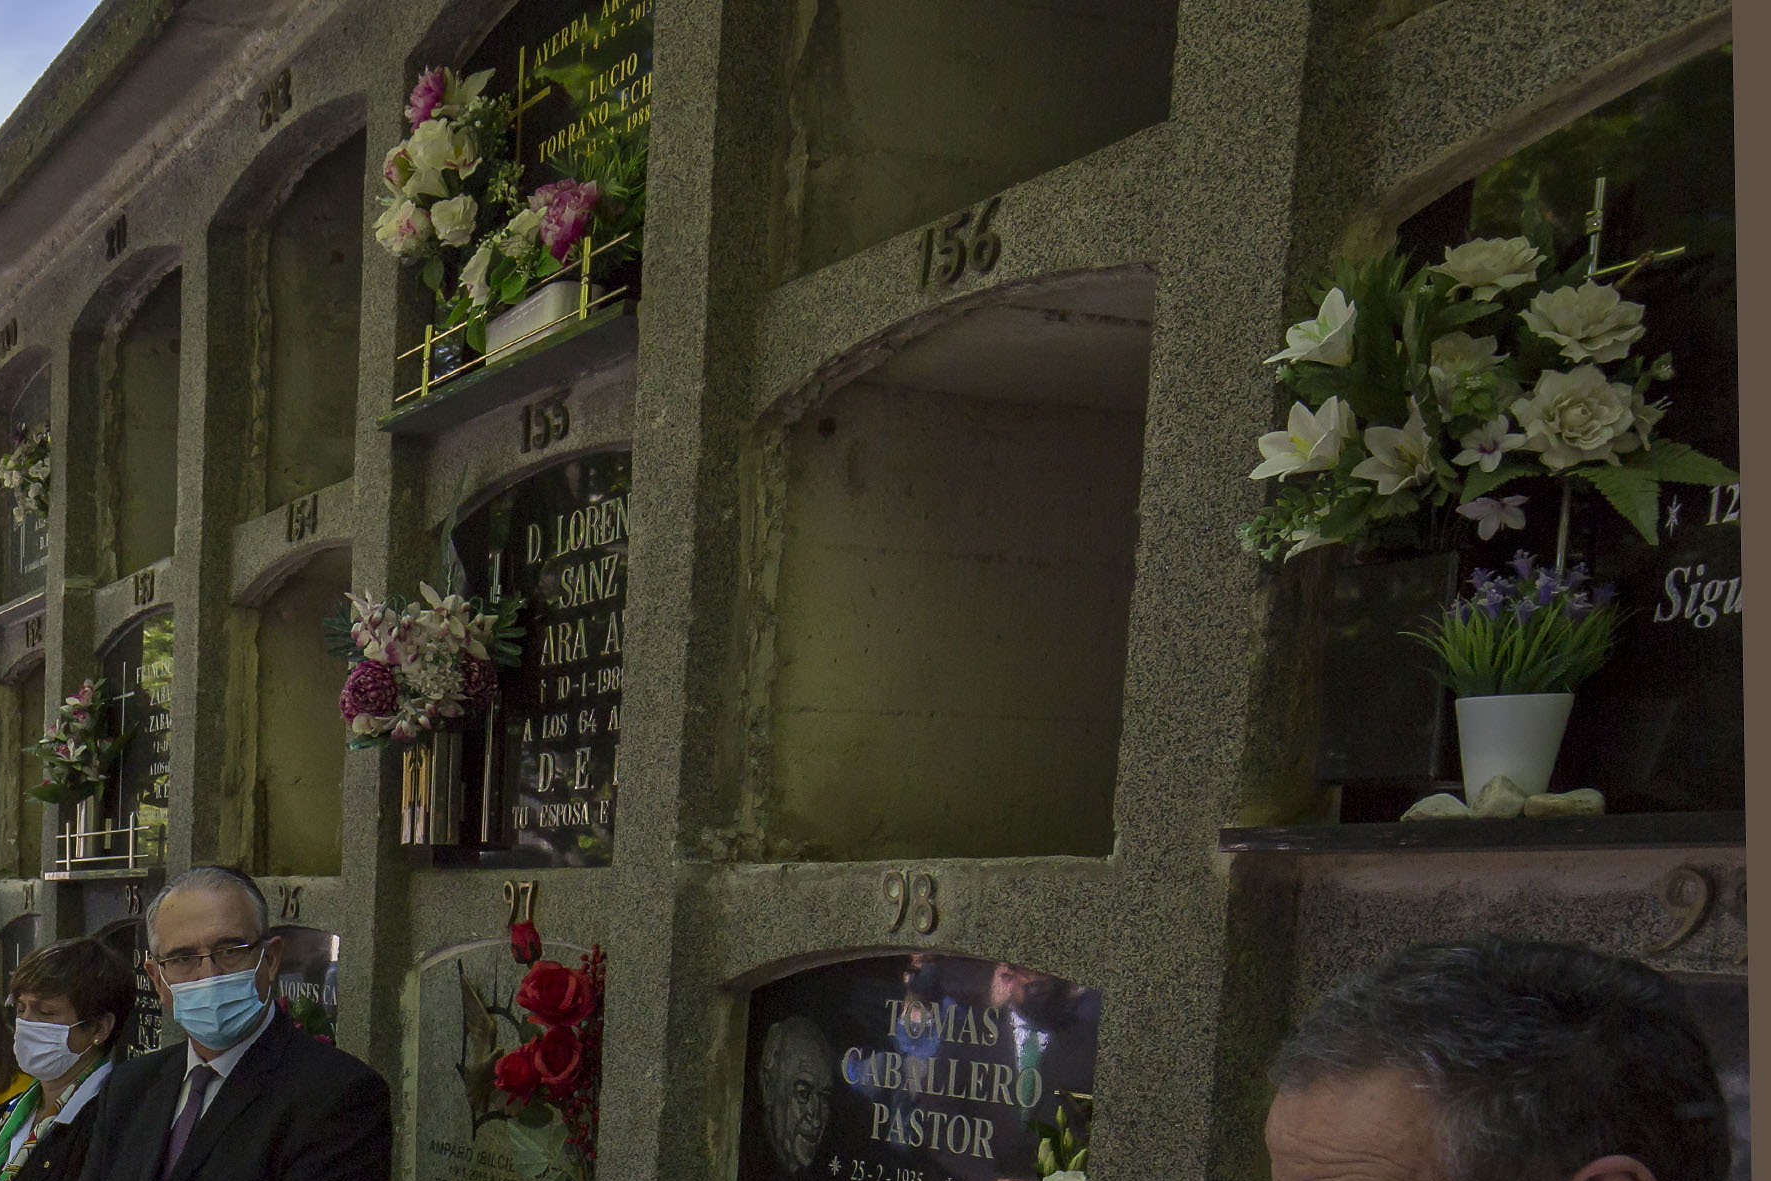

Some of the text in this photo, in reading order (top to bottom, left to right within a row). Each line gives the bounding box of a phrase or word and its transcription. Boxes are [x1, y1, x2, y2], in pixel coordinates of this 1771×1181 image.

[534, 12, 588, 70] AYERRA
[589, 52, 637, 103] LUCIO
[538, 101, 609, 164] TORRANO
[915, 196, 1002, 290] 156
[558, 552, 619, 610] SANZ
[542, 712, 568, 740] LOS
[579, 707, 597, 735] 64
[539, 802, 591, 828] ESPOSA
[278, 884, 303, 919] 96
[503, 880, 539, 928] 97
[882, 871, 937, 935] 98
[885, 999, 1000, 1048] TOMAS
[840, 1046, 1042, 1109] CABALLERO
[869, 1102, 994, 1160] PASTOR
